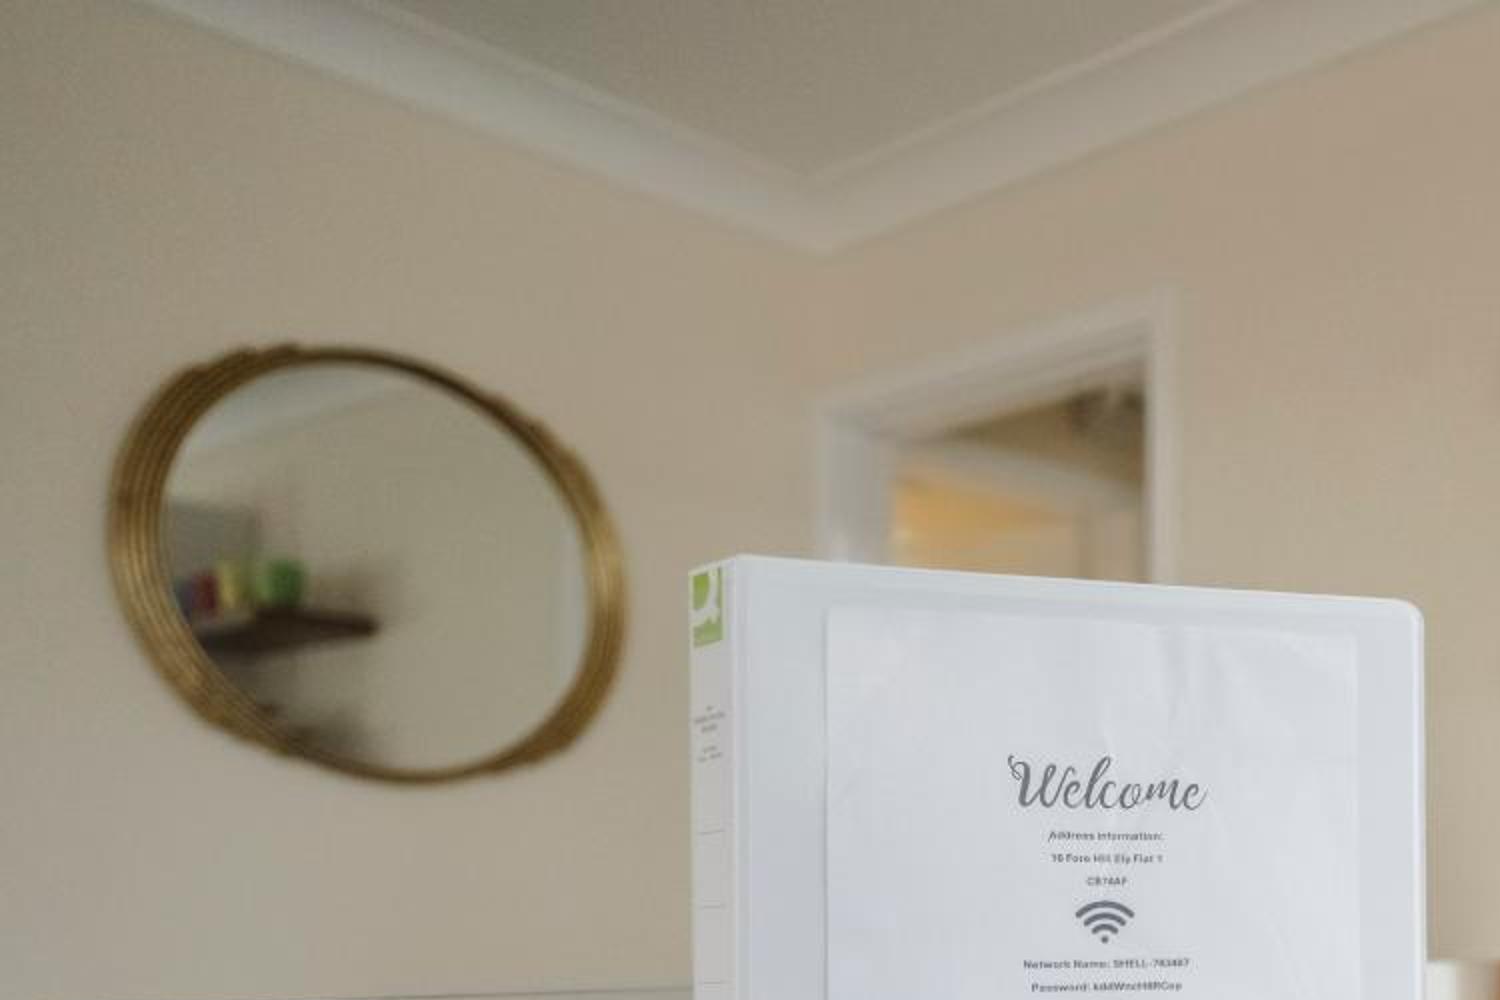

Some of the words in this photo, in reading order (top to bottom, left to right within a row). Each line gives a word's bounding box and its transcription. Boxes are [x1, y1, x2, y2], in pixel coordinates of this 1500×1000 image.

[1008, 755, 1207, 810] Welcome
[1048, 831, 1095, 841] Address
[1133, 853, 1154, 863] Flat
[1023, 959, 1071, 969] Network
[1073, 959, 1109, 969] Name:
[1031, 982, 1087, 993] Password:
